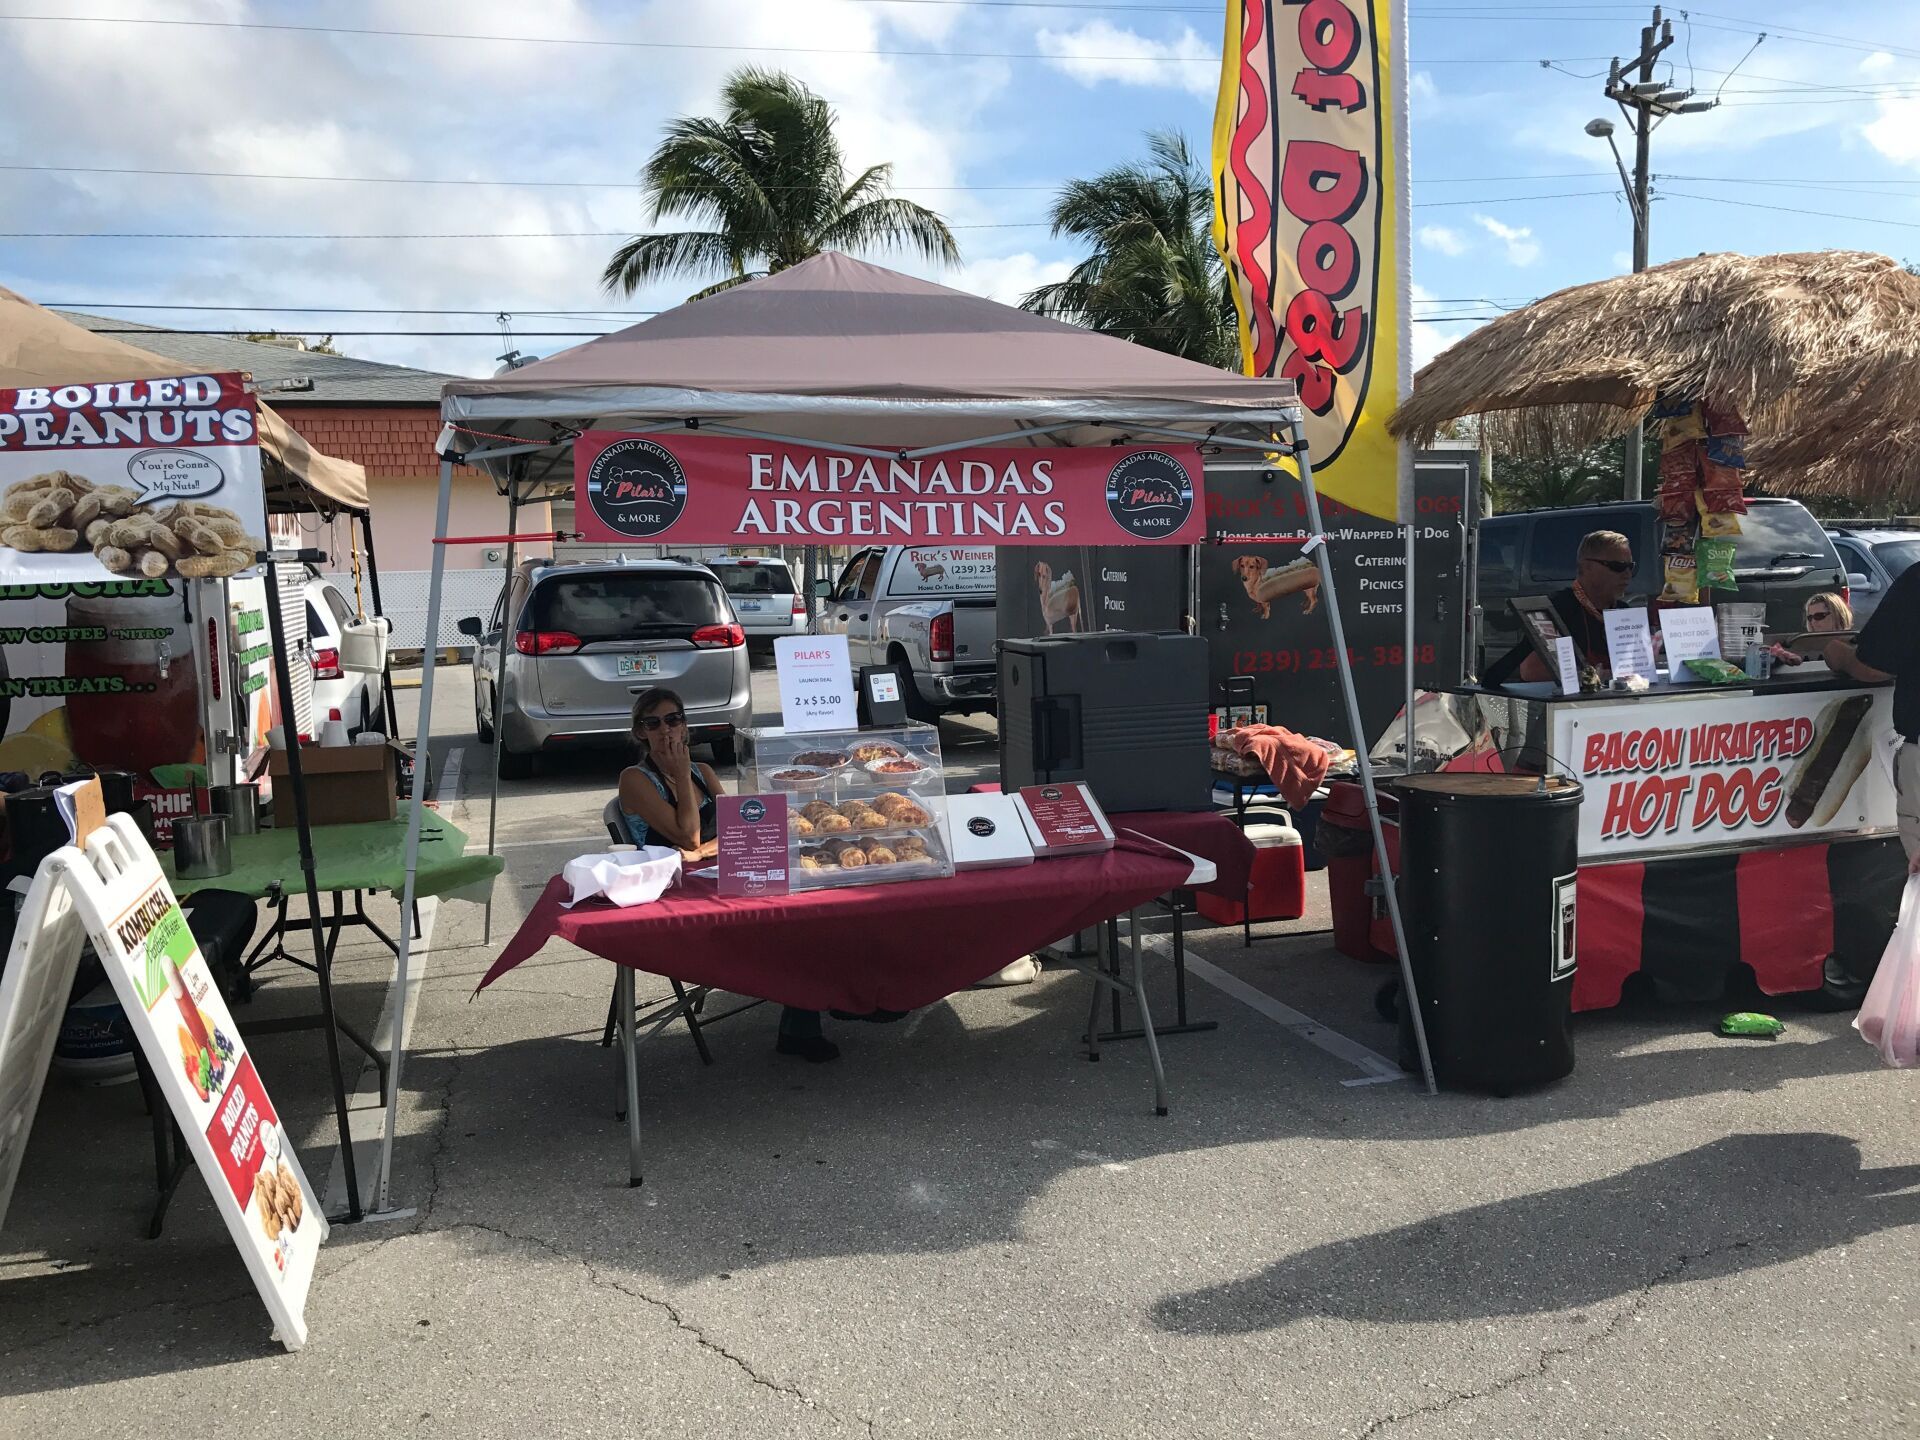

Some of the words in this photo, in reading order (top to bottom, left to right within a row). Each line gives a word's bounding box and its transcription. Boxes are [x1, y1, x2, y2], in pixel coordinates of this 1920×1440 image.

[1291, 0, 1364, 111] ot
[13, 375, 222, 410] BOILED
[0, 409, 253, 447] PEANUTS
[139, 459, 174, 470] You're
[176, 459, 210, 469] Gonna
[592, 441, 635, 480] EMPANADAS
[636, 442, 684, 484] ARGENTINAS
[1109, 453, 1146, 489] EMPANADAS
[1147, 453, 1189, 489] ARGENTINAS
[163, 470, 189, 480] Love
[748, 453, 1054, 496] EMPANADAS
[153, 481, 170, 492] My
[172, 480, 200, 490] Nuts!!
[615, 481, 665, 499] Pilar's
[1131, 488, 1173, 505] Pilar's
[1416, 495, 1461, 513] OGS
[618, 513, 626, 523] &
[628, 514, 661, 523] MORE
[732, 498, 1067, 537] ARGENTINAS
[1133, 518, 1140, 527] &
[1142, 517, 1171, 527] MORE
[1296, 528, 1394, 541] BAON-WRAPPED
[1397, 527, 1421, 539] HT
[1424, 527, 1450, 539] DOG
[910, 550, 948, 561] RICK'S
[950, 549, 994, 560] WEINER
[951, 565, 977, 574] (239)
[1359, 578, 1404, 590] PICNICS
[1360, 602, 1403, 614] EVENTS
[27, 626, 106, 642] COFFEE
[794, 650, 831, 660] PILAR'S
[1234, 650, 1300, 675] (239)
[794, 697, 801, 706] 2
[811, 695, 818, 706] $
[820, 695, 841, 705] 5.00
[1582, 727, 1685, 775] BACON
[1688, 716, 1815, 767] WRAPPED
[1600, 774, 1692, 838] HOT
[1691, 766, 1784, 830] DOG
[117, 887, 171, 955] KOMBUCHA
[220, 1083, 246, 1137] BOILED
[230, 1101, 259, 1168] PEANUTS
